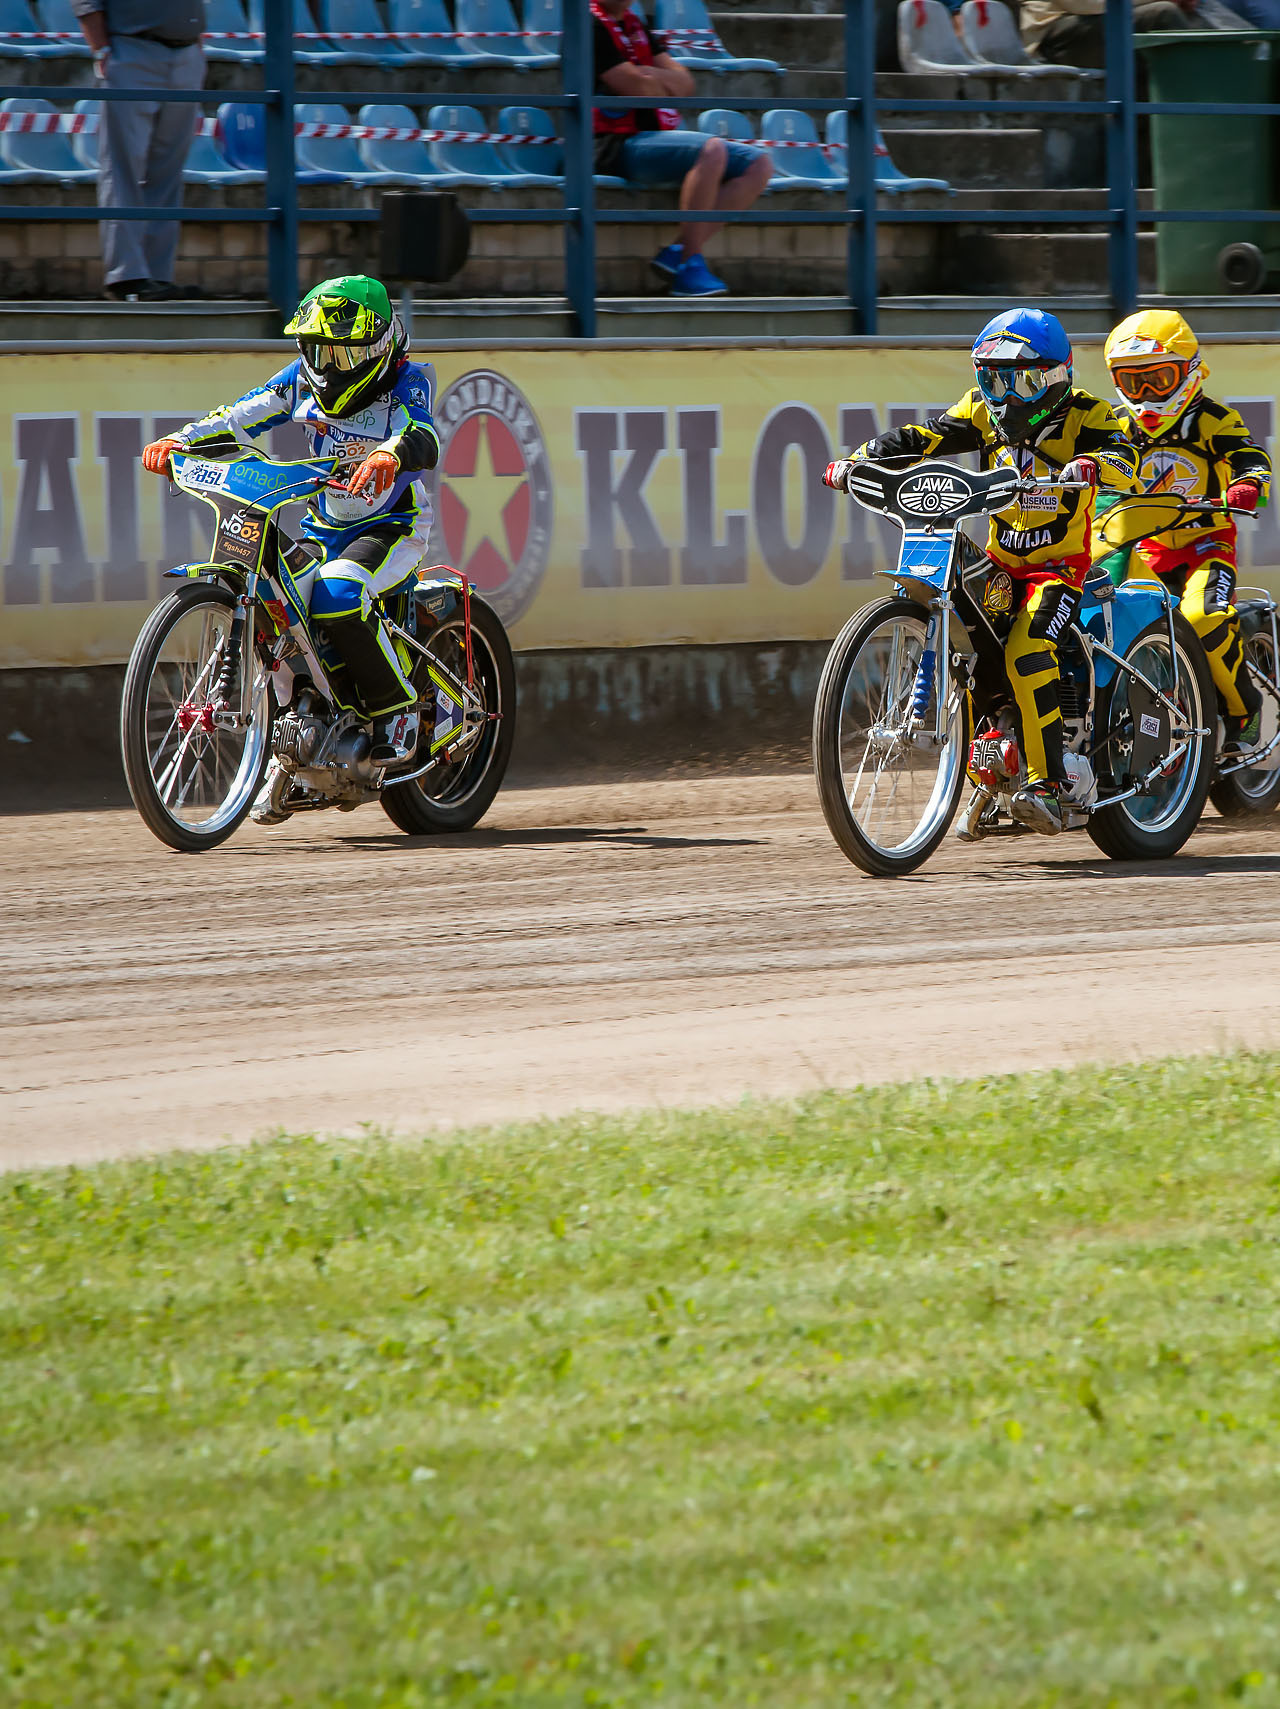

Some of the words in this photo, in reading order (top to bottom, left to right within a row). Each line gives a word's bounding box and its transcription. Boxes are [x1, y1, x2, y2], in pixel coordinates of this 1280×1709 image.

[912, 477, 955, 492] JAWA
[1022, 494, 1058, 506] USEKLIS
[1045, 592, 1075, 640] LATVIJA
